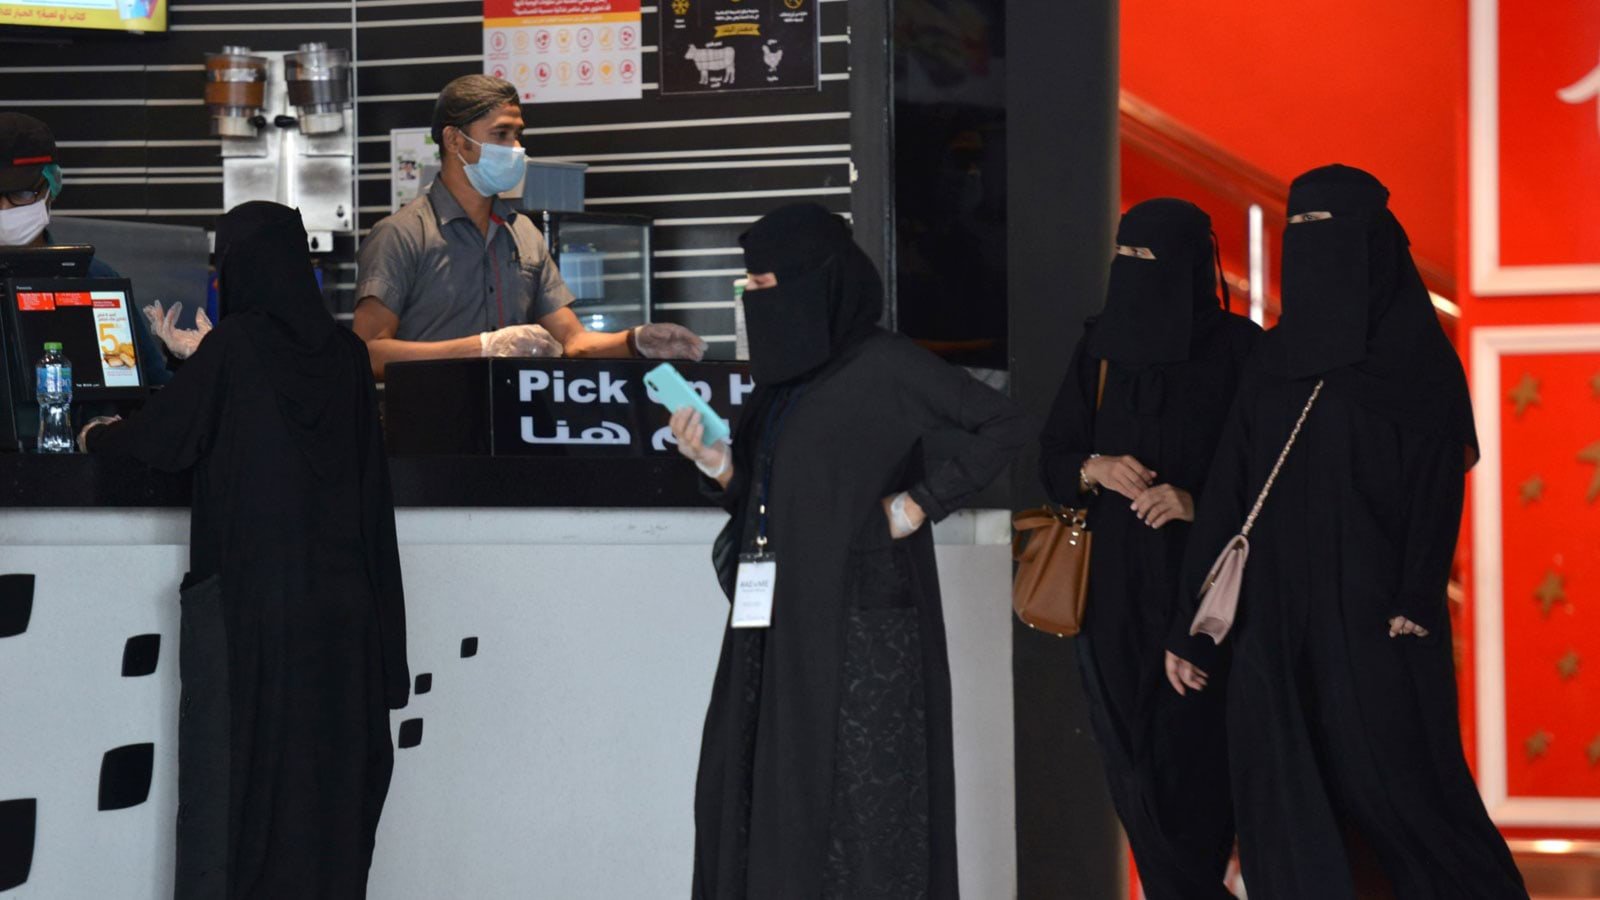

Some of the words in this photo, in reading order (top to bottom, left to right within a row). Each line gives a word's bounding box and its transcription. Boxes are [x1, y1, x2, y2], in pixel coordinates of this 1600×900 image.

[99, 323, 120, 356] 5
[519, 370, 629, 403] Pick
[521, 416, 631, 445] هنا
